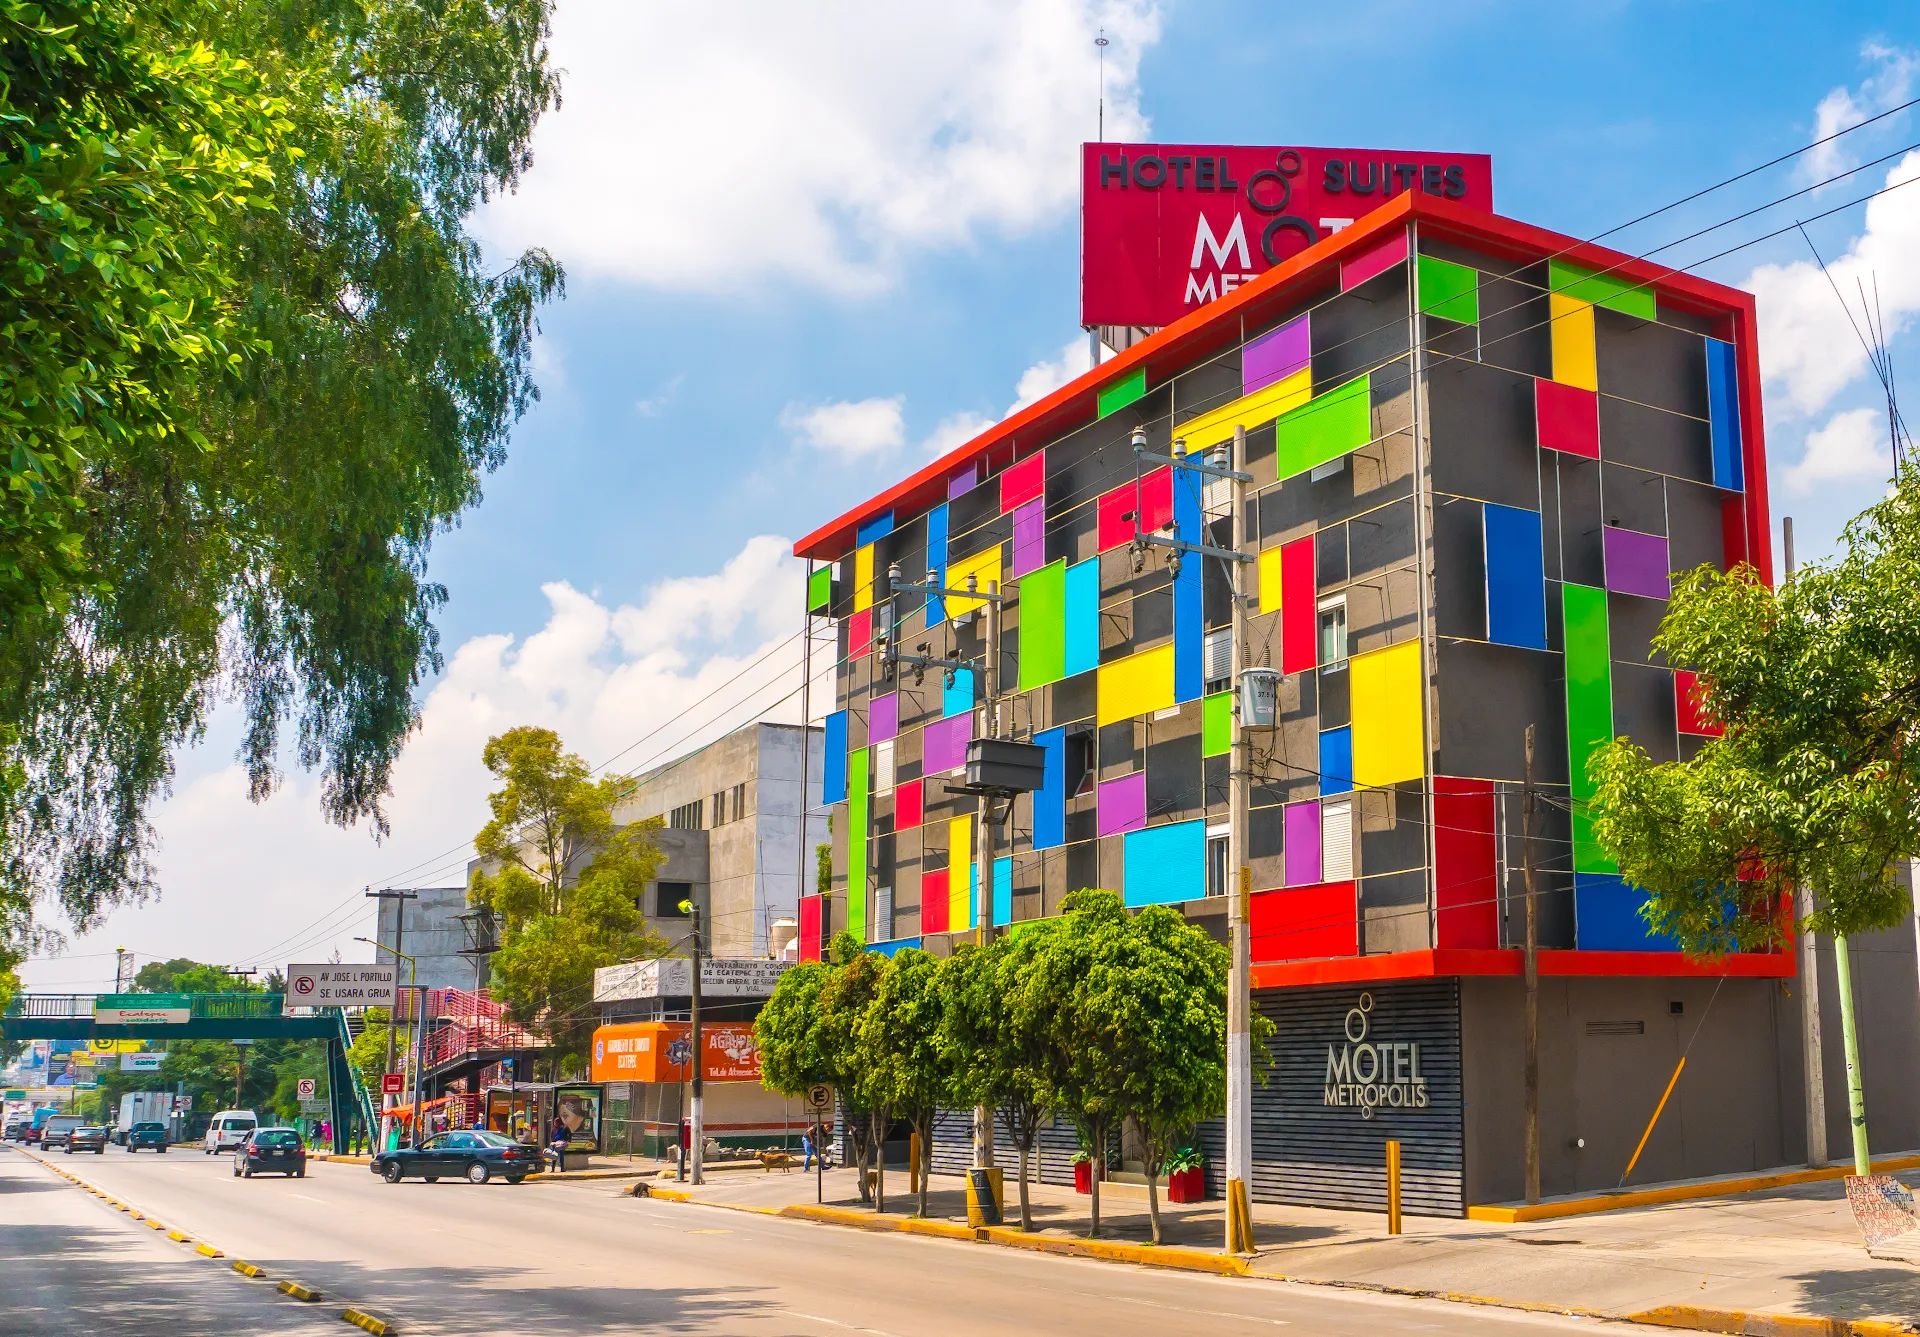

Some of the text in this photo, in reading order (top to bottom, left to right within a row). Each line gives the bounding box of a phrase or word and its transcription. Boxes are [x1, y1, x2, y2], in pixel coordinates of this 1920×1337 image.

[1100, 154, 1468, 198] HOTEL SUITES
[1184, 272, 1261, 305] ME
[320, 972, 392, 982] AV JOSE L PORTILLO
[717, 969, 752, 977] ECATEPEC
[320, 988, 391, 998] SE USARA GRUA
[119, 1010, 169, 1018] Ecatepec
[1325, 1042, 1426, 1085] MOTEL
[1323, 1083, 1428, 1108] METROPOLIS
